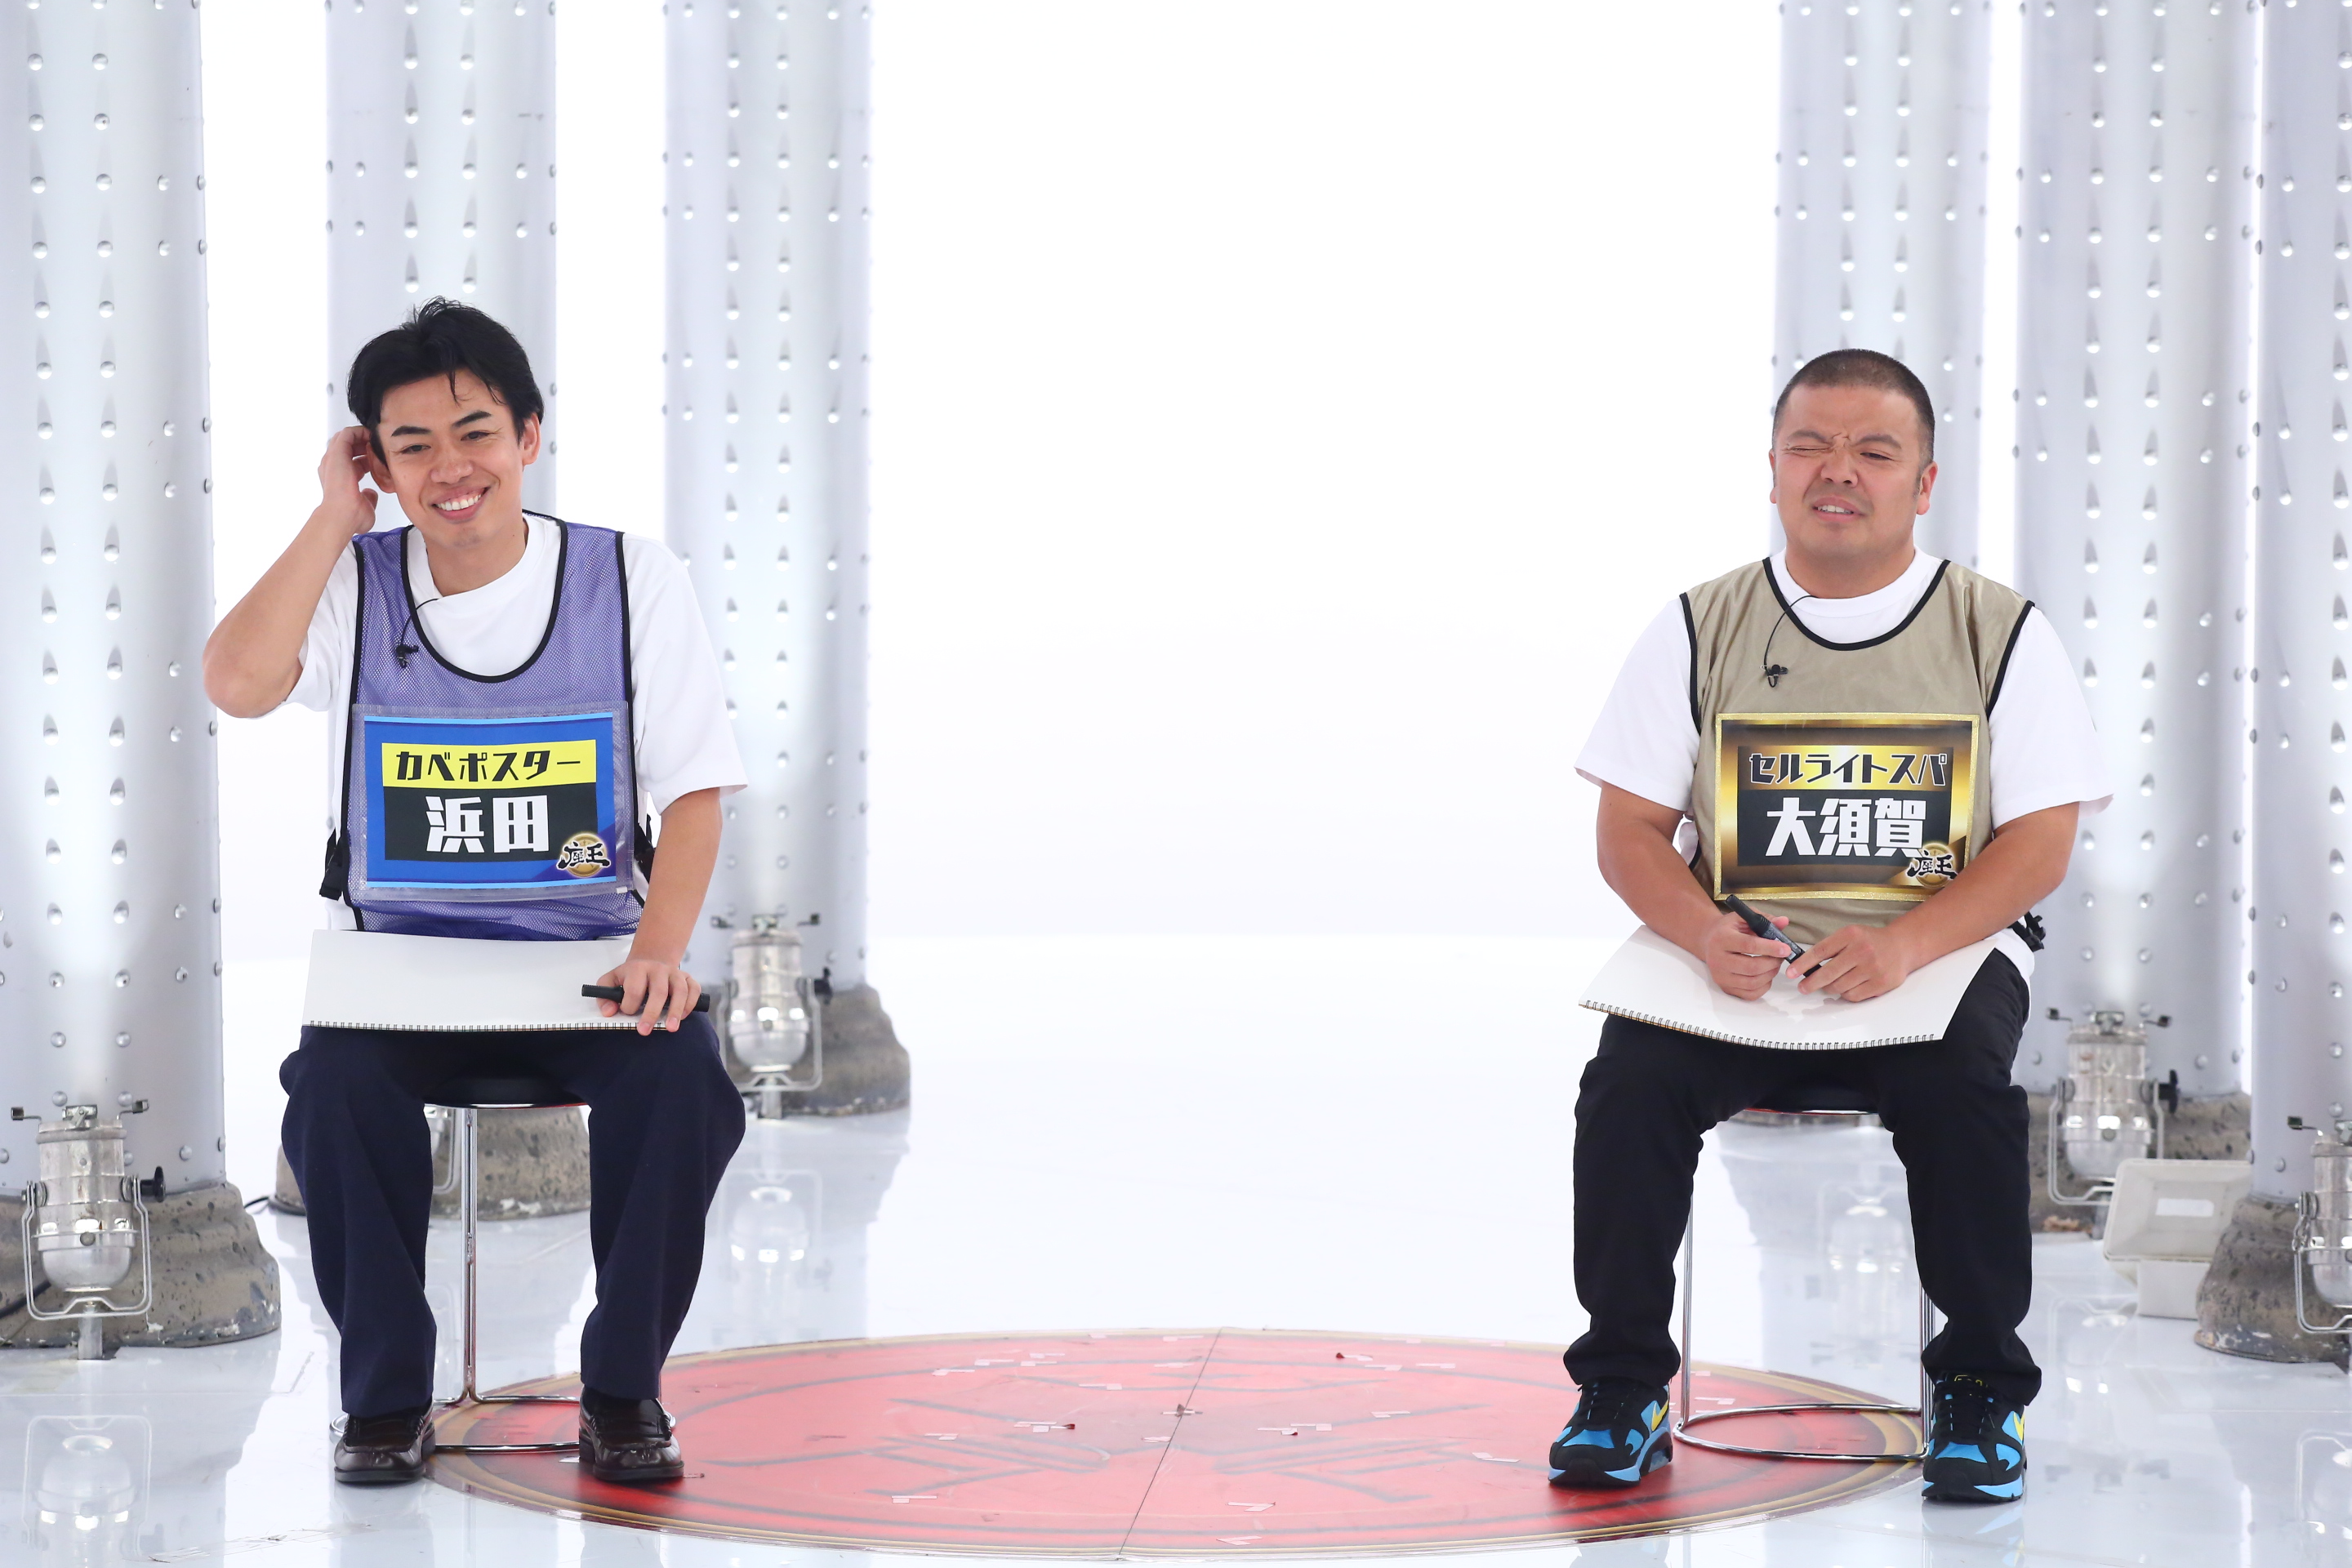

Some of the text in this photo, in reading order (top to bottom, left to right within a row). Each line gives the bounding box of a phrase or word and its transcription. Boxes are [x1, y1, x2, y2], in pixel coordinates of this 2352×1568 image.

[396, 751, 581, 782] カベポスター
[1749, 753, 1947, 786] セルライトスパ
[425, 795, 549, 853] 浜田
[1765, 797, 1927, 857] 大須賀
[557, 841, 611, 870] 座王
